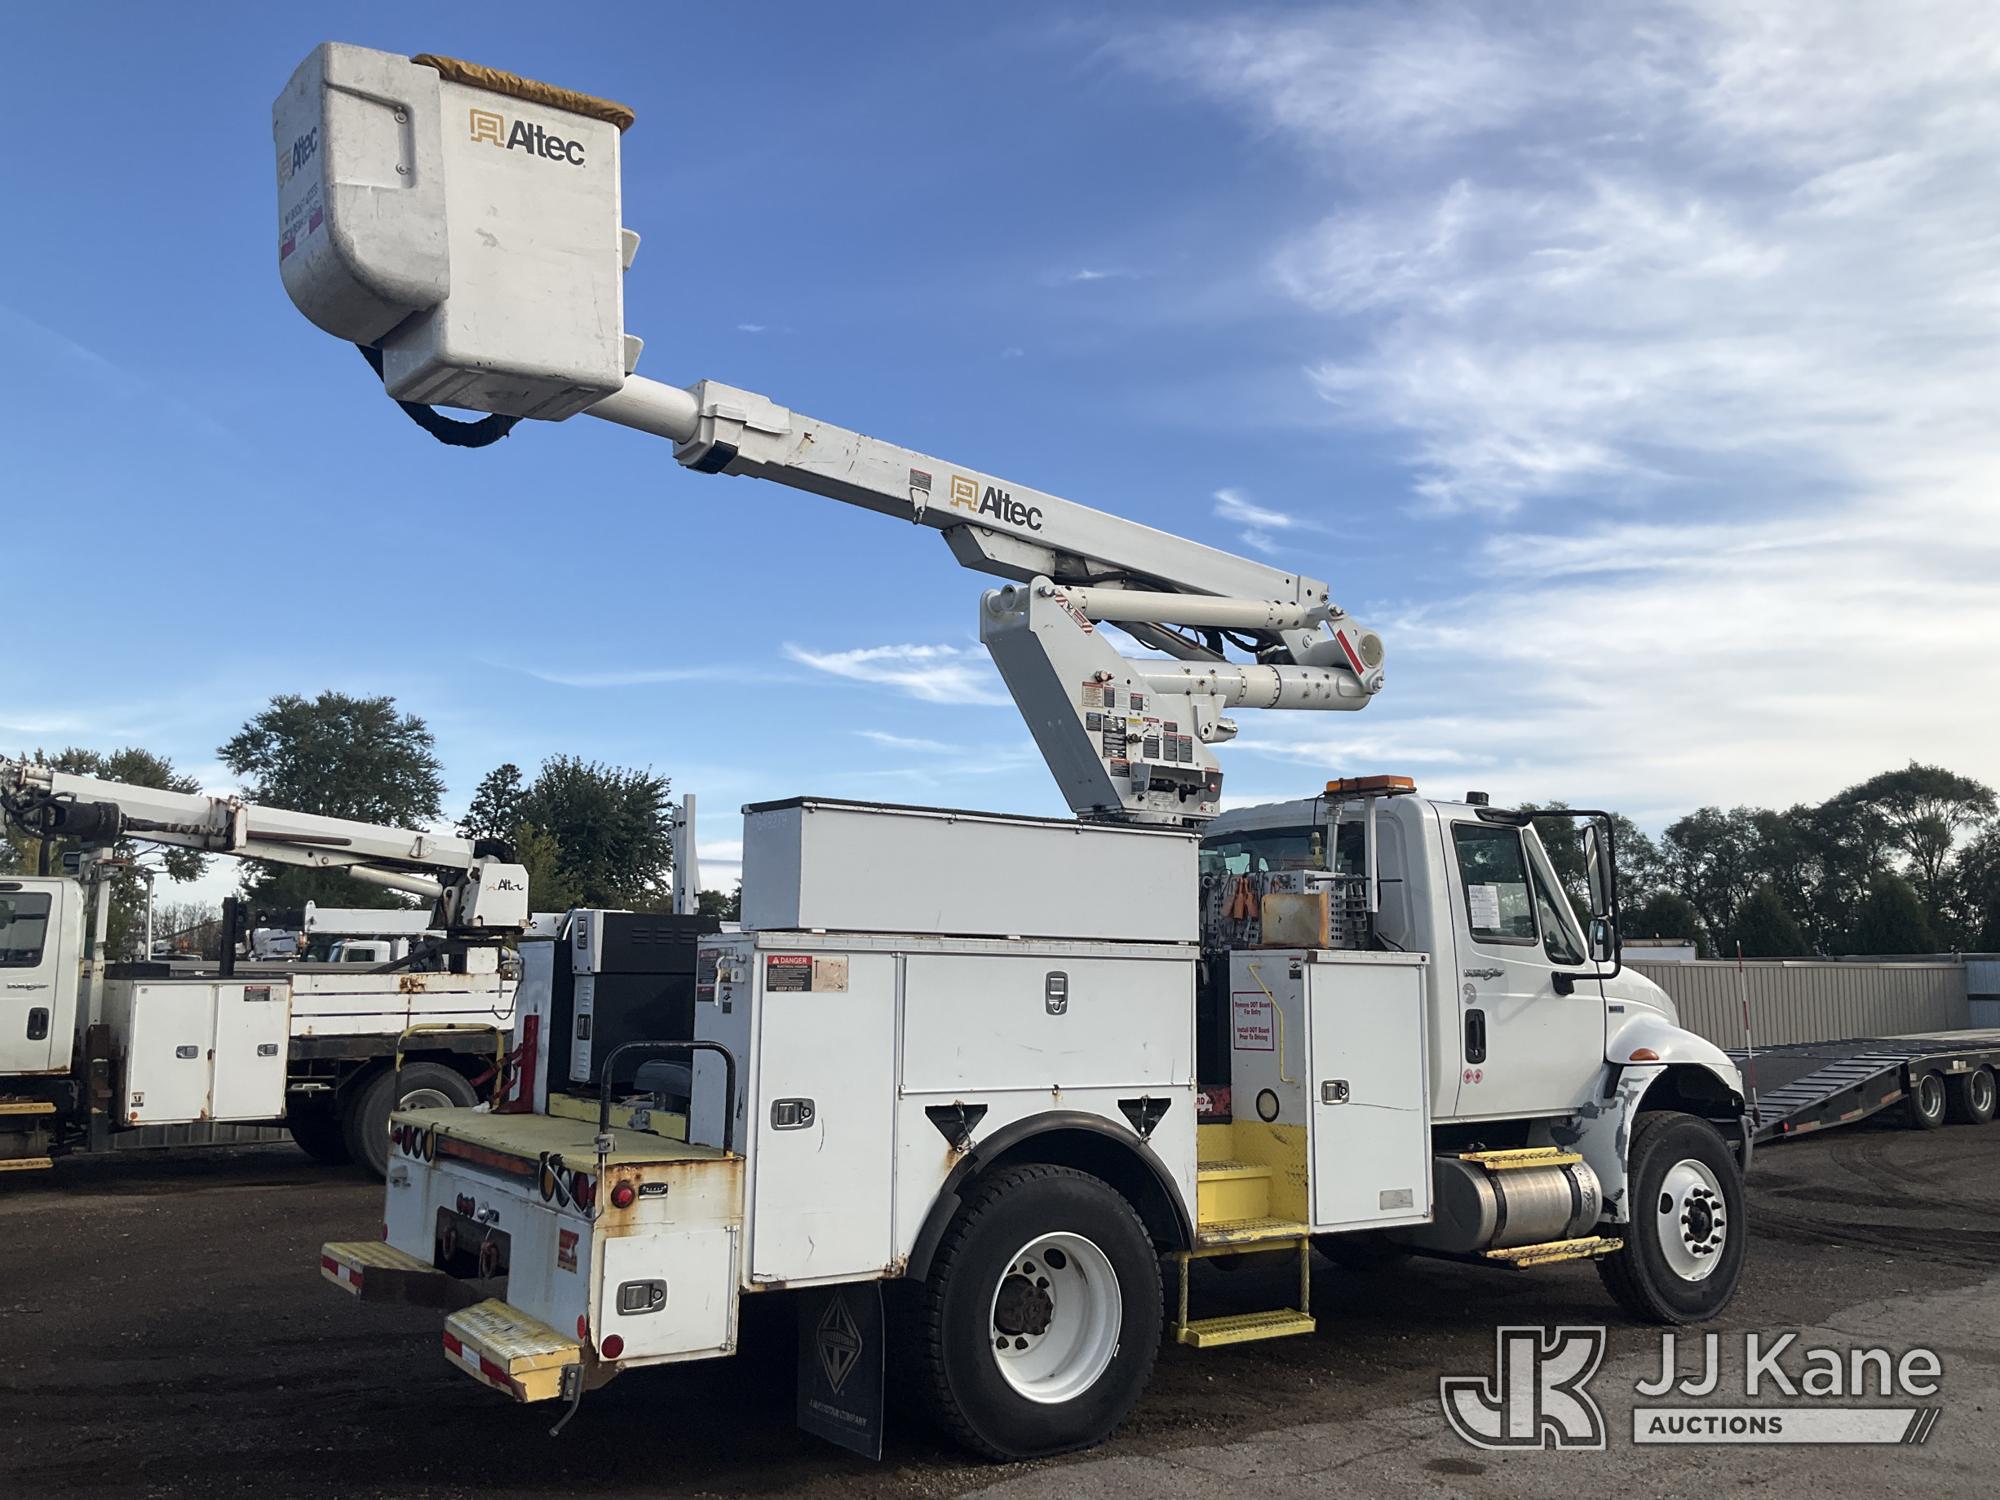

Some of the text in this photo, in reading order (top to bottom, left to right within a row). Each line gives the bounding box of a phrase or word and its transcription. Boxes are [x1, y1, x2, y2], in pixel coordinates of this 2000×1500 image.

[291, 126, 318, 176] Altec
[506, 120, 585, 166] Altec
[978, 486, 1043, 531] Altec
